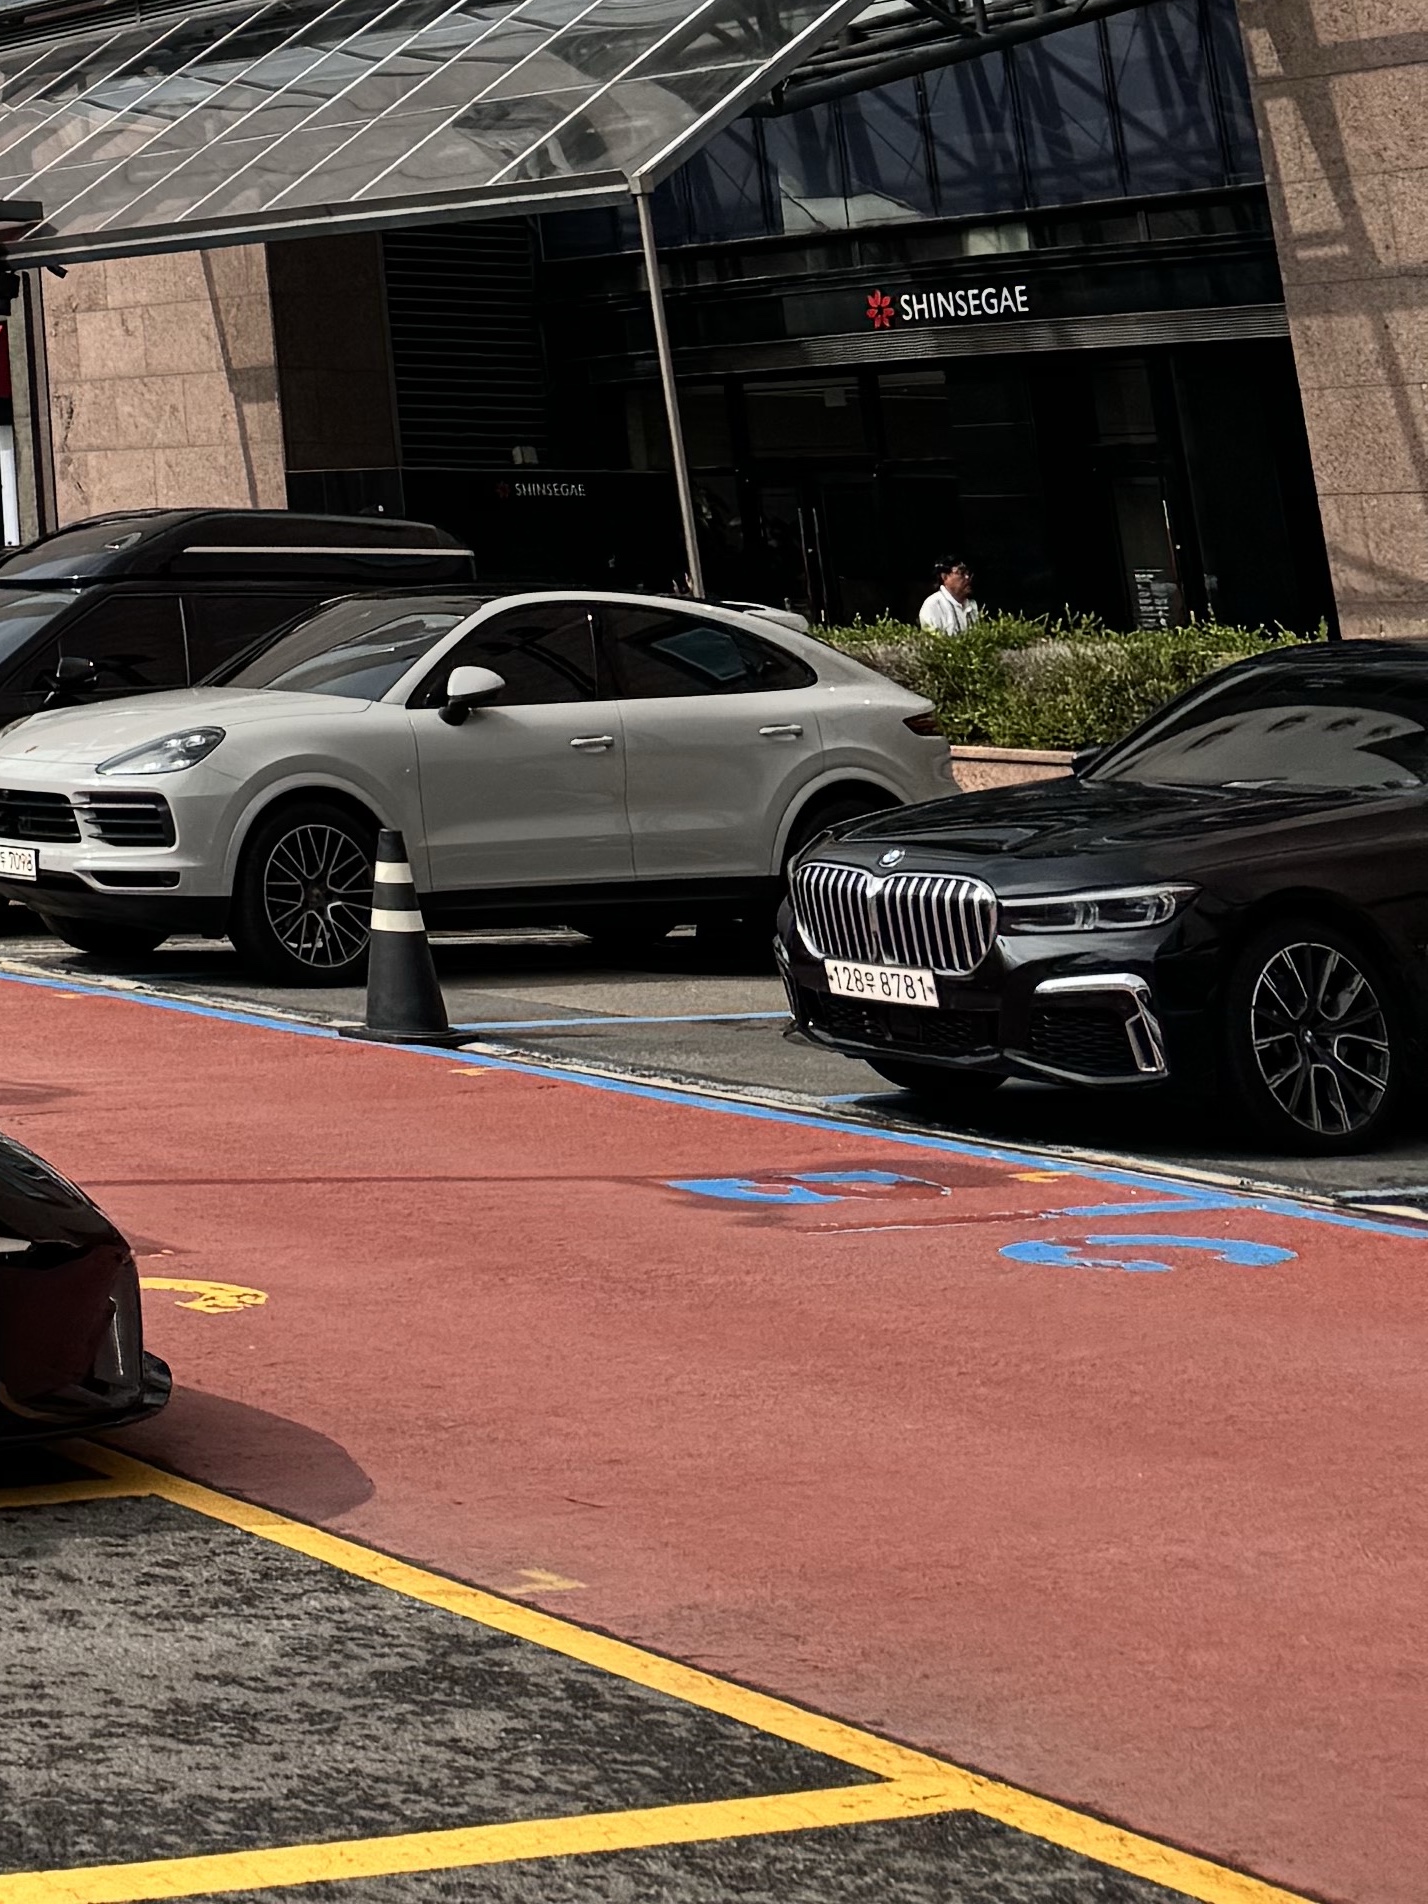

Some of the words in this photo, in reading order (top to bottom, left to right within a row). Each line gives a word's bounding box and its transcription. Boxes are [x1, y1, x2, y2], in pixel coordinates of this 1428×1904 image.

[900, 285, 1030, 321] SHINSEGAE
[514, 482, 587, 497] SHINSEGAE
[879, 971, 928, 1002] 8781
